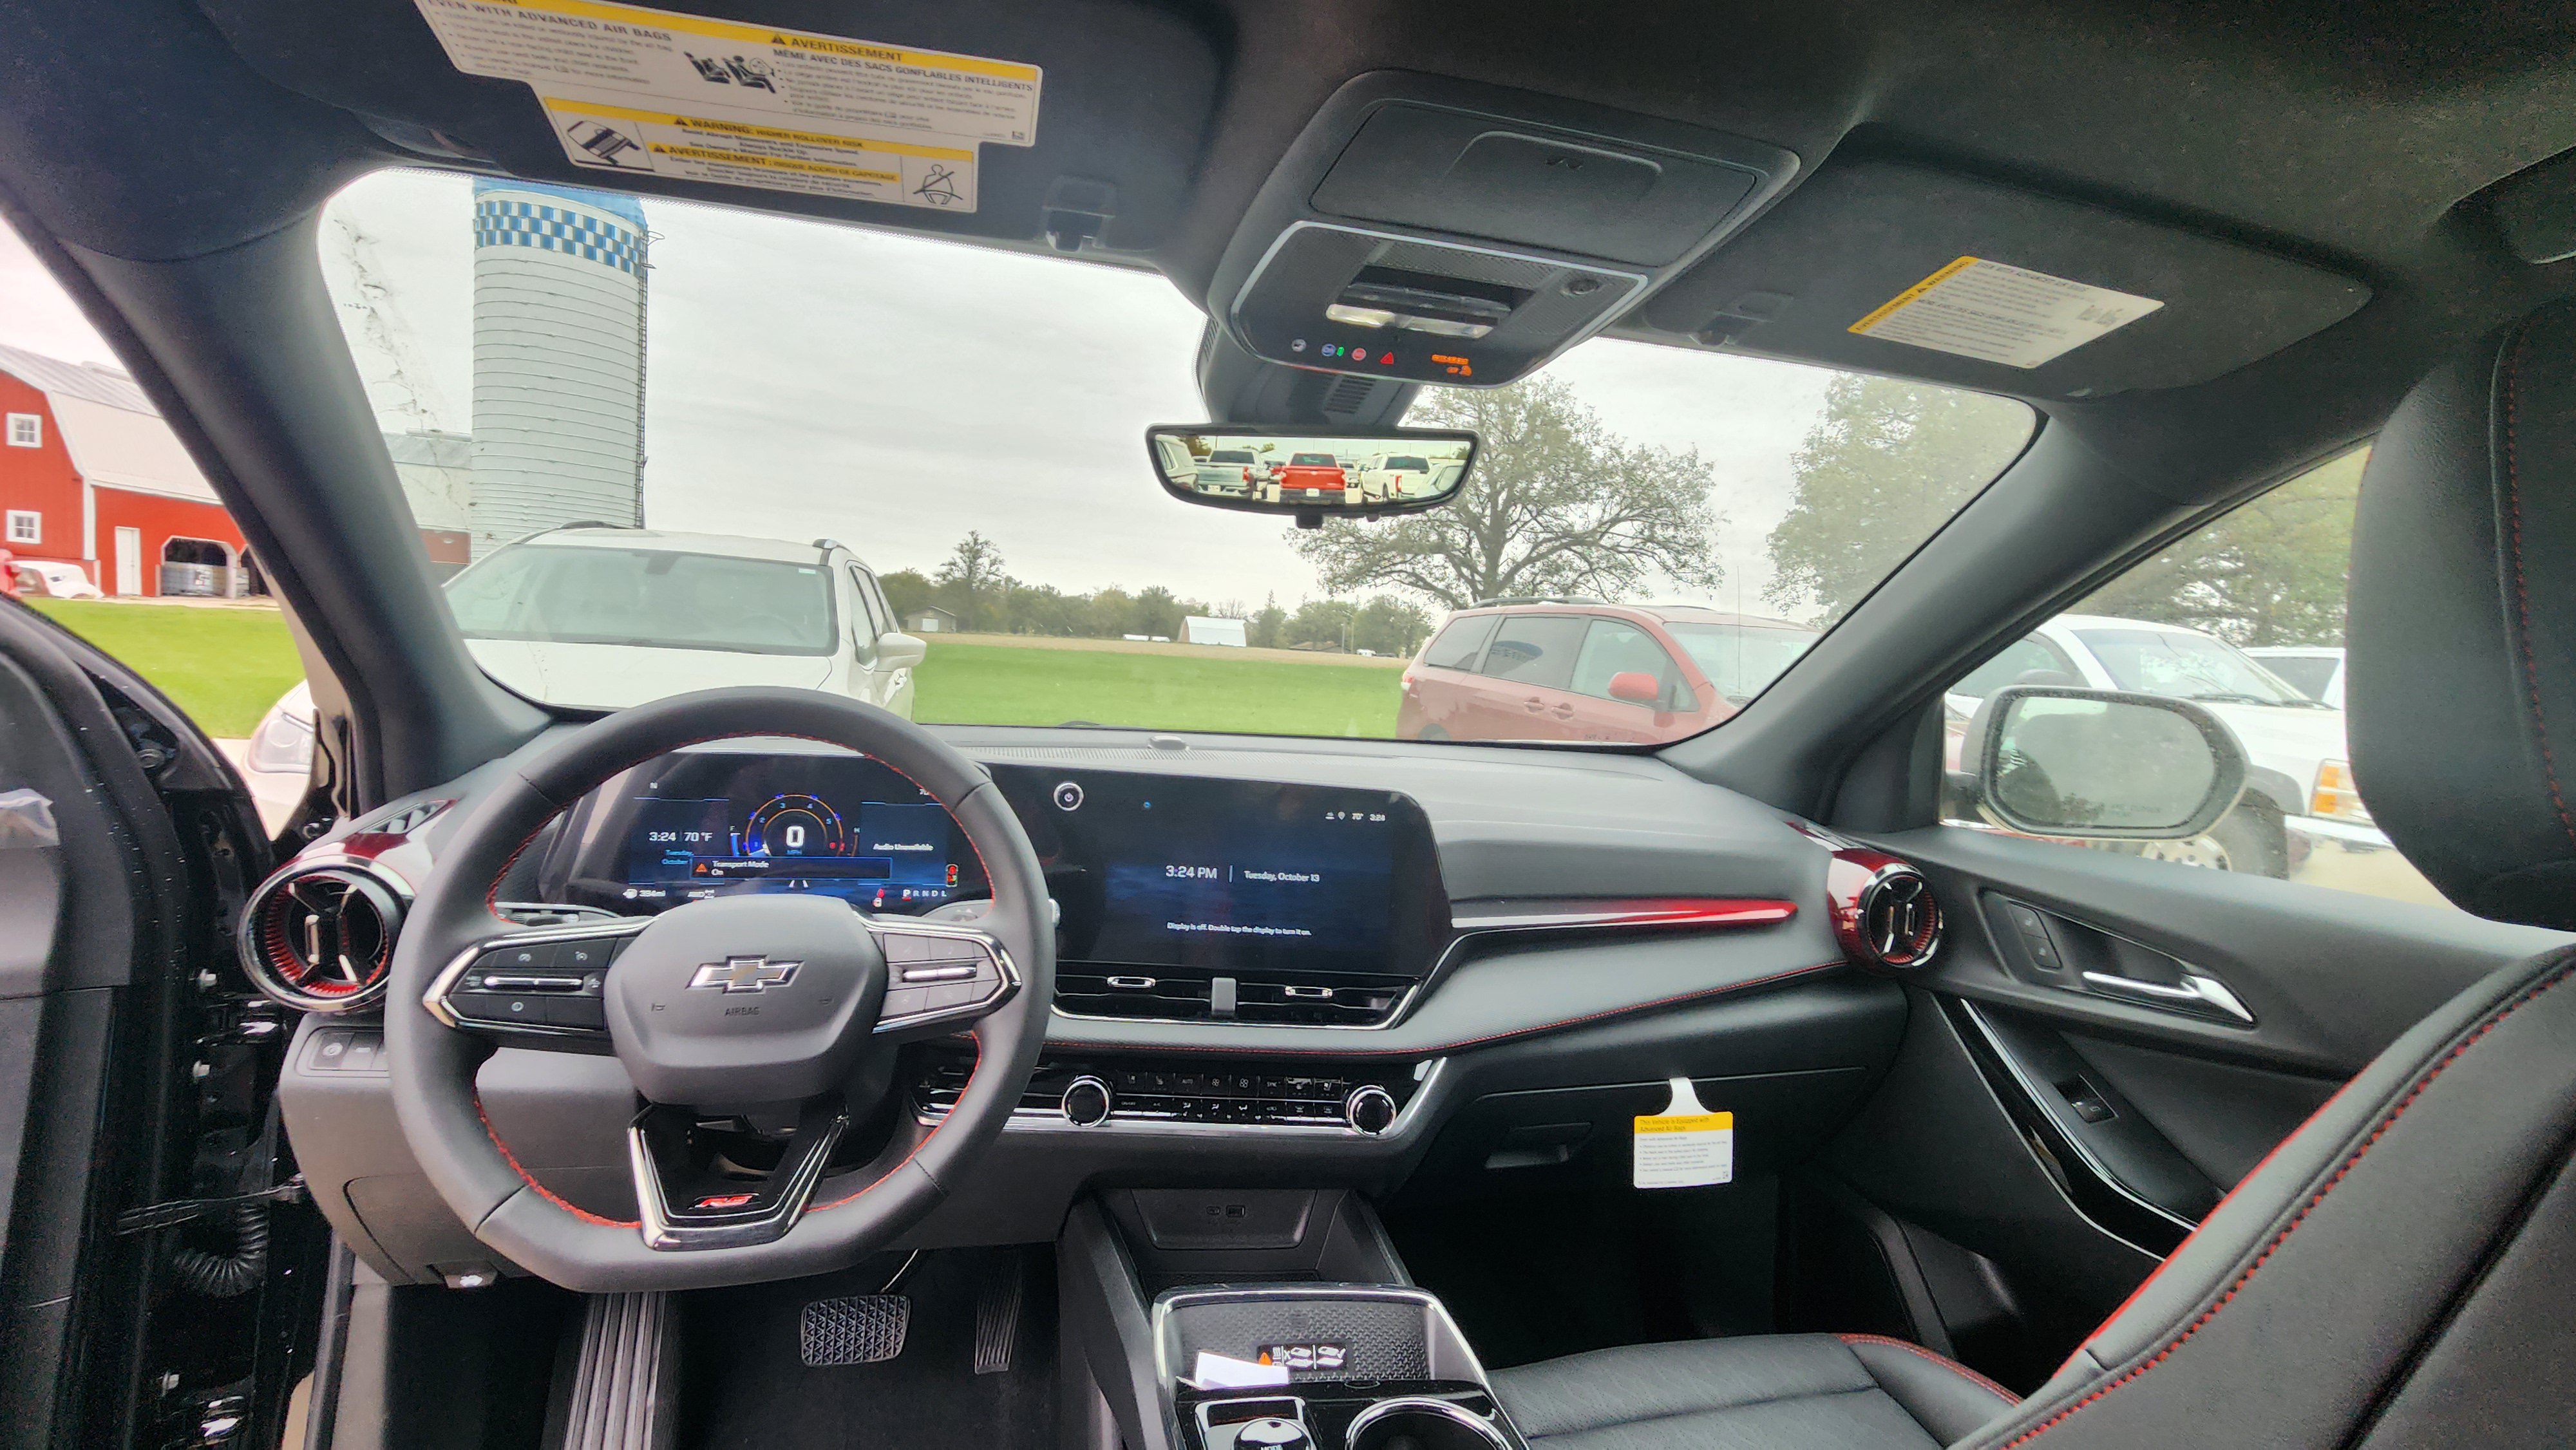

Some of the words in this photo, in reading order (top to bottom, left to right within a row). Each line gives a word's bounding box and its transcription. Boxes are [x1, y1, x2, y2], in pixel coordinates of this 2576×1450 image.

[471, 4, 513, 17] WITH
[518, 10, 598, 30] ADVANCED
[603, 23, 628, 35] AIR
[632, 28, 672, 41] BAGS
[791, 38, 902, 61] AVERTISSEMENT
[810, 53, 837, 64] AVEC
[841, 59, 861, 68] DES
[865, 62, 893, 72] SACS
[896, 66, 962, 82] GONFLABLES
[965, 75, 1034, 92] INTELLIGENTS
[649, 832, 677, 842] 3:24
[786, 825, 804, 847] 0
[1166, 865, 1195, 879] 3:24
[1197, 867, 1218, 880] PM
[1244, 870, 1277, 882] Tuesday,
[1278, 873, 1309, 882] October
[1311, 874, 1320, 882] 13
[903, 889, 911, 898] P
[1166, 921, 1190, 932] Display
[724, 1006, 760, 1017] AIRBAG
[694, 1195, 753, 1209] RS
